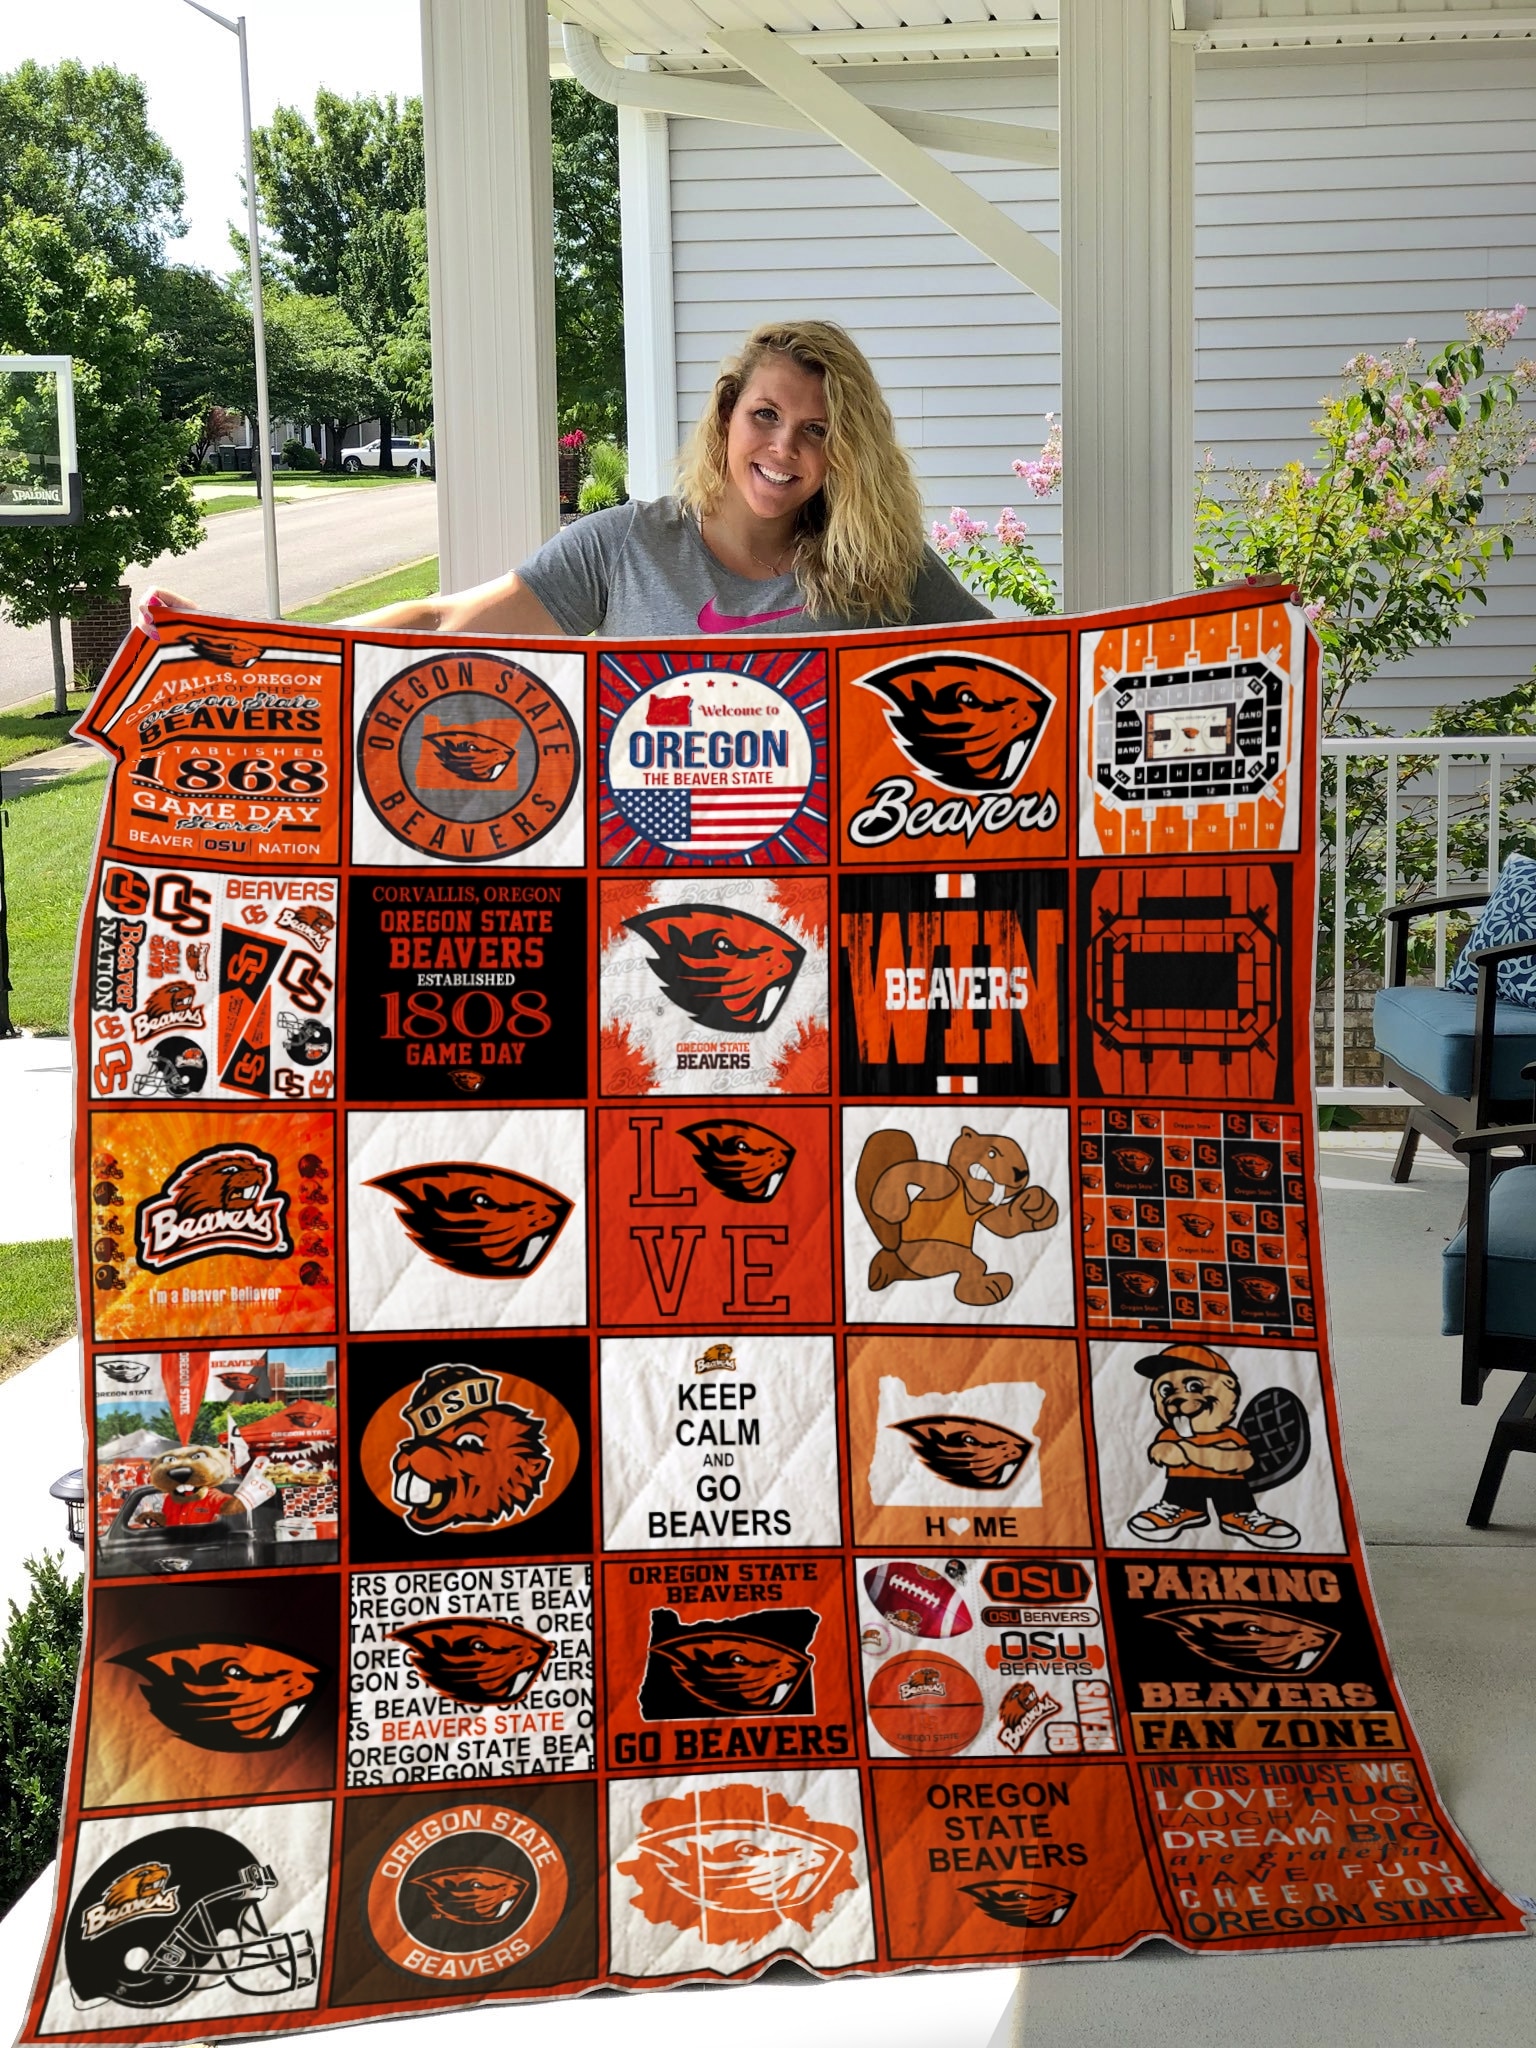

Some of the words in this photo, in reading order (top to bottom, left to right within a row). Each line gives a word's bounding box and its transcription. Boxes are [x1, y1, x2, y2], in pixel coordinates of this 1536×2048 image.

[12, 490, 59, 501] SPALDING
[125, 672, 237, 725] CORVALLIS,
[242, 674, 322, 687] OREGON
[138, 693, 238, 733] Oregon
[242, 692, 320, 712] State
[368, 661, 473, 751] OREGON
[495, 670, 570, 756] STATE
[698, 704, 762, 717] Welcome
[766, 705, 780, 716] to
[140, 707, 321, 745] BEAVERS
[1239, 711, 1262, 720] BAND
[629, 730, 789, 769] OREGON
[1240, 738, 1262, 746] BAND
[128, 758, 329, 798] 1868
[643, 772, 669, 785] THE
[673, 772, 728, 785] BEAVER
[732, 771, 774, 784] STATE
[133, 792, 235, 820] GAME
[249, 804, 319, 823] DAY
[379, 790, 556, 853] BEAVERS
[848, 776, 1059, 847] Beavers
[175, 816, 277, 834] Score!
[129, 829, 193, 848] BEAVER
[203, 839, 246, 852] OSU
[258, 843, 320, 855] NATION
[226, 879, 334, 901] BEAVERS
[372, 886, 480, 904] CORVALLIS,
[484, 886, 561, 902] OREGON
[380, 911, 472, 932] OREGON
[481, 910, 553, 932] STATE
[97, 921, 117, 1009] NATION
[116, 922, 143, 1010] Beaver
[389, 937, 544, 969] BEAVERS
[417, 973, 516, 986] ESTABLISHED
[840, 908, 1064, 1064] WIN
[885, 966, 1029, 1010] BEAVERS
[135, 1009, 203, 1038] Beavers
[380, 991, 552, 1039] 1808
[406, 1043, 472, 1065] GAME
[481, 1042, 525, 1065] DAY
[676, 1042, 717, 1052] OREGON
[720, 1042, 750, 1052] STATE
[677, 1053, 750, 1070] BEAVERS
[151, 1207, 273, 1252] Beavers
[150, 1288, 167, 1304] I'm
[171, 1290, 179, 1304] a
[182, 1287, 226, 1303] Beaver
[231, 1287, 281, 1302] Believer
[211, 1359, 266, 1368] BEAVERS
[129, 1389, 152, 1397] STATE
[179, 1386, 190, 1415] STATE
[419, 1381, 490, 1430] OSU
[678, 1383, 757, 1411] KEEP
[306, 1429, 331, 1437] STATE
[675, 1419, 760, 1446] CALM
[703, 1453, 734, 1467] AND
[697, 1475, 741, 1502] GO
[649, 1509, 791, 1538] BEAVERS
[395, 1571, 493, 1594] OREGON
[501, 1567, 572, 1589] STATE
[629, 1565, 729, 1584] OREGON
[739, 1563, 818, 1582] STATE
[991, 1565, 1082, 1599] OSU
[1124, 1565, 1342, 1603] PARKING
[447, 1592, 520, 1614] STATE
[666, 1584, 782, 1603] BEAVERS
[989, 1612, 1019, 1622] OSU
[1024, 1611, 1090, 1622] BEAVERS
[1000, 1631, 1087, 1660] OSU
[1000, 1662, 1093, 1676] BEAVERS
[1139, 1682, 1377, 1708] BEAVERS
[382, 1717, 487, 1742] BEAVERS
[494, 1711, 564, 1735] STATE
[1001, 1696, 1058, 1750] Beavers
[1139, 1719, 1237, 1749] FAN
[1257, 1719, 1394, 1748] ZONE
[350, 1743, 449, 1768] OREGON
[457, 1737, 531, 1760] STATE
[615, 1731, 661, 1764] GO
[675, 1724, 849, 1761] BEAVERS
[392, 1762, 493, 1784] OREGON
[501, 1757, 574, 1776] STATE
[1150, 1766, 1179, 1788] IN
[1188, 1766, 1251, 1786] THIS
[1261, 1764, 1353, 1785] HOUSE
[1361, 1763, 1409, 1783] WE
[926, 1781, 1070, 1810] OREGON
[1157, 1787, 1293, 1811] LOVE
[1303, 1784, 1420, 1806] HUG
[945, 1814, 1052, 1841] STATE
[1158, 1810, 1293, 1828] LAUGH
[1310, 1809, 1336, 1824] A
[1349, 1806, 1423, 1823] LOT
[381, 1809, 482, 1880] OREGON
[491, 1811, 558, 1868] STATE
[1163, 1826, 1332, 1850] DREAM
[1347, 1821, 1440, 1844] BIG
[928, 1843, 1088, 1873] BEAVERS
[1170, 1852, 1233, 1867] are
[1259, 1841, 1440, 1869] grateful
[1172, 1868, 1309, 1887] HAVE
[1342, 1860, 1452, 1879] FUN
[1179, 1883, 1338, 1909] CHEER
[1368, 1876, 1470, 1899] FOR
[87, 1891, 175, 1935] Beavers
[1187, 1902, 1367, 1938] OREGON
[1373, 1896, 1489, 1922] STATE
[403, 1938, 531, 1977] BEAVERS
